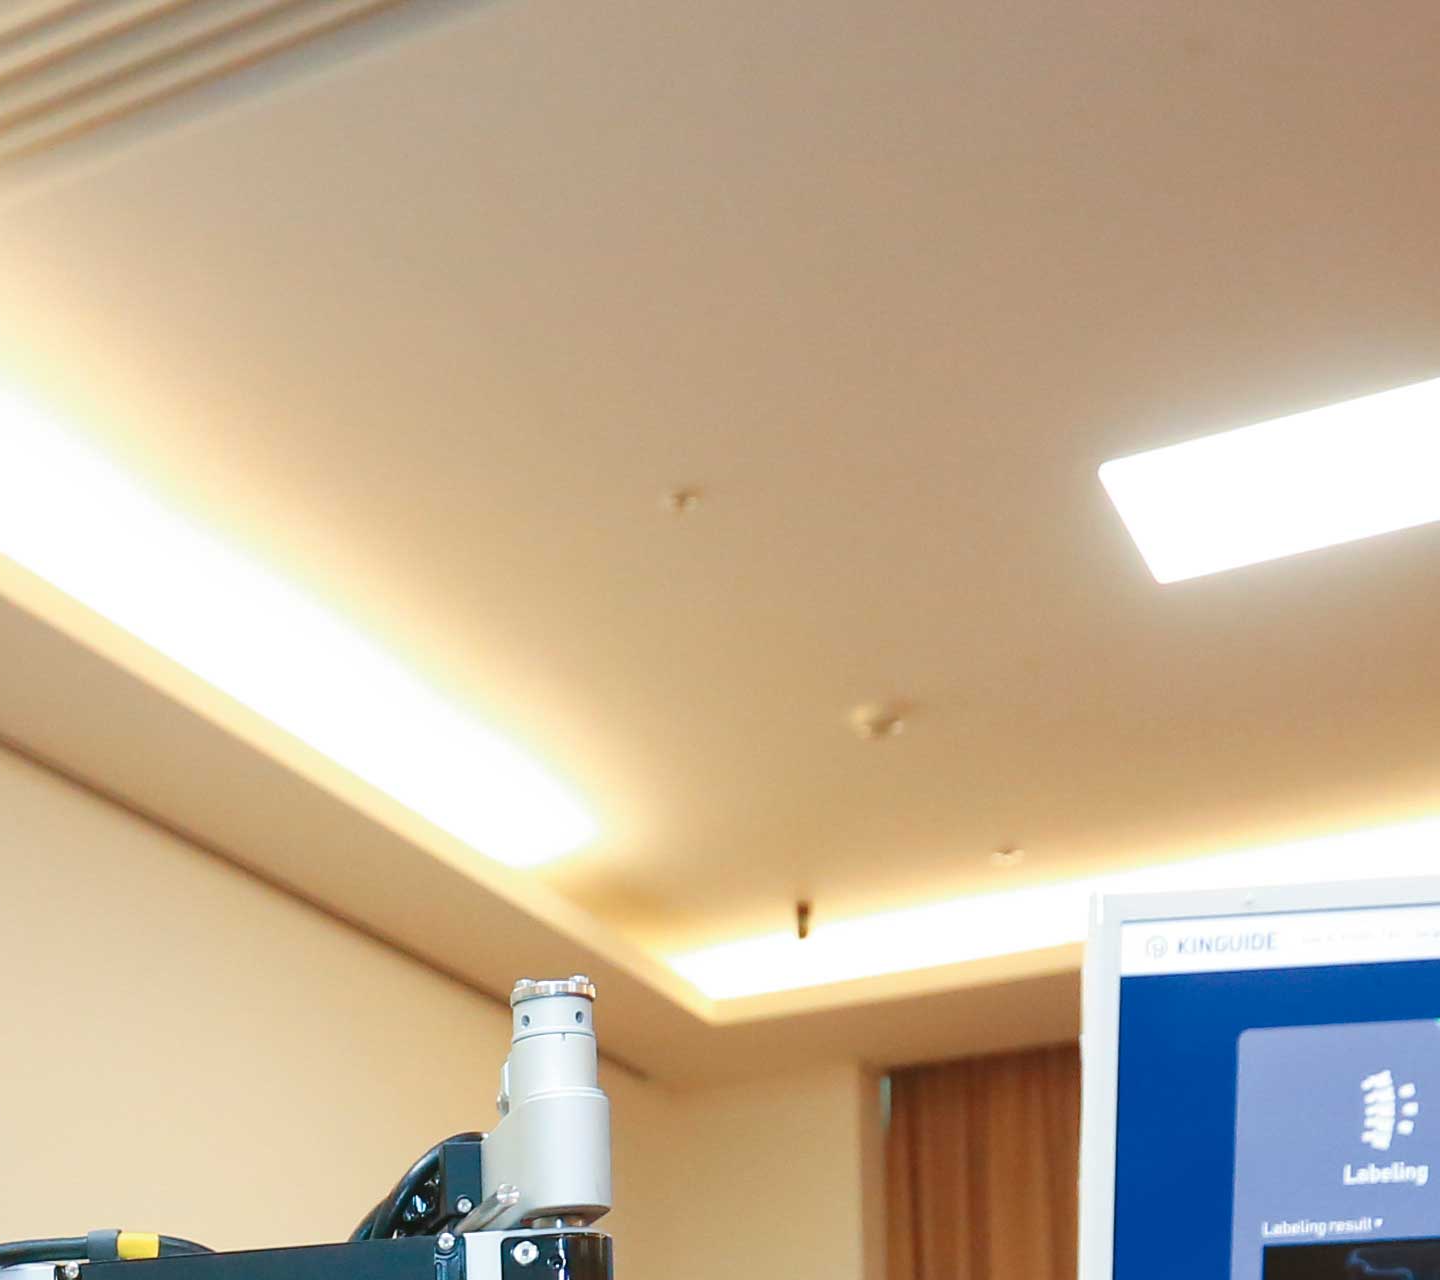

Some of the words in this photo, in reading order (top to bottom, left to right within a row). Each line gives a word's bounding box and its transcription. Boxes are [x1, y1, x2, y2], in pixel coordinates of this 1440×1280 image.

[1176, 931, 1278, 955] KINGUIDE
[1343, 1161, 1429, 1185] Labeling
[1261, 1219, 1327, 1238] Labeling
[1329, 1217, 1372, 1234] result
